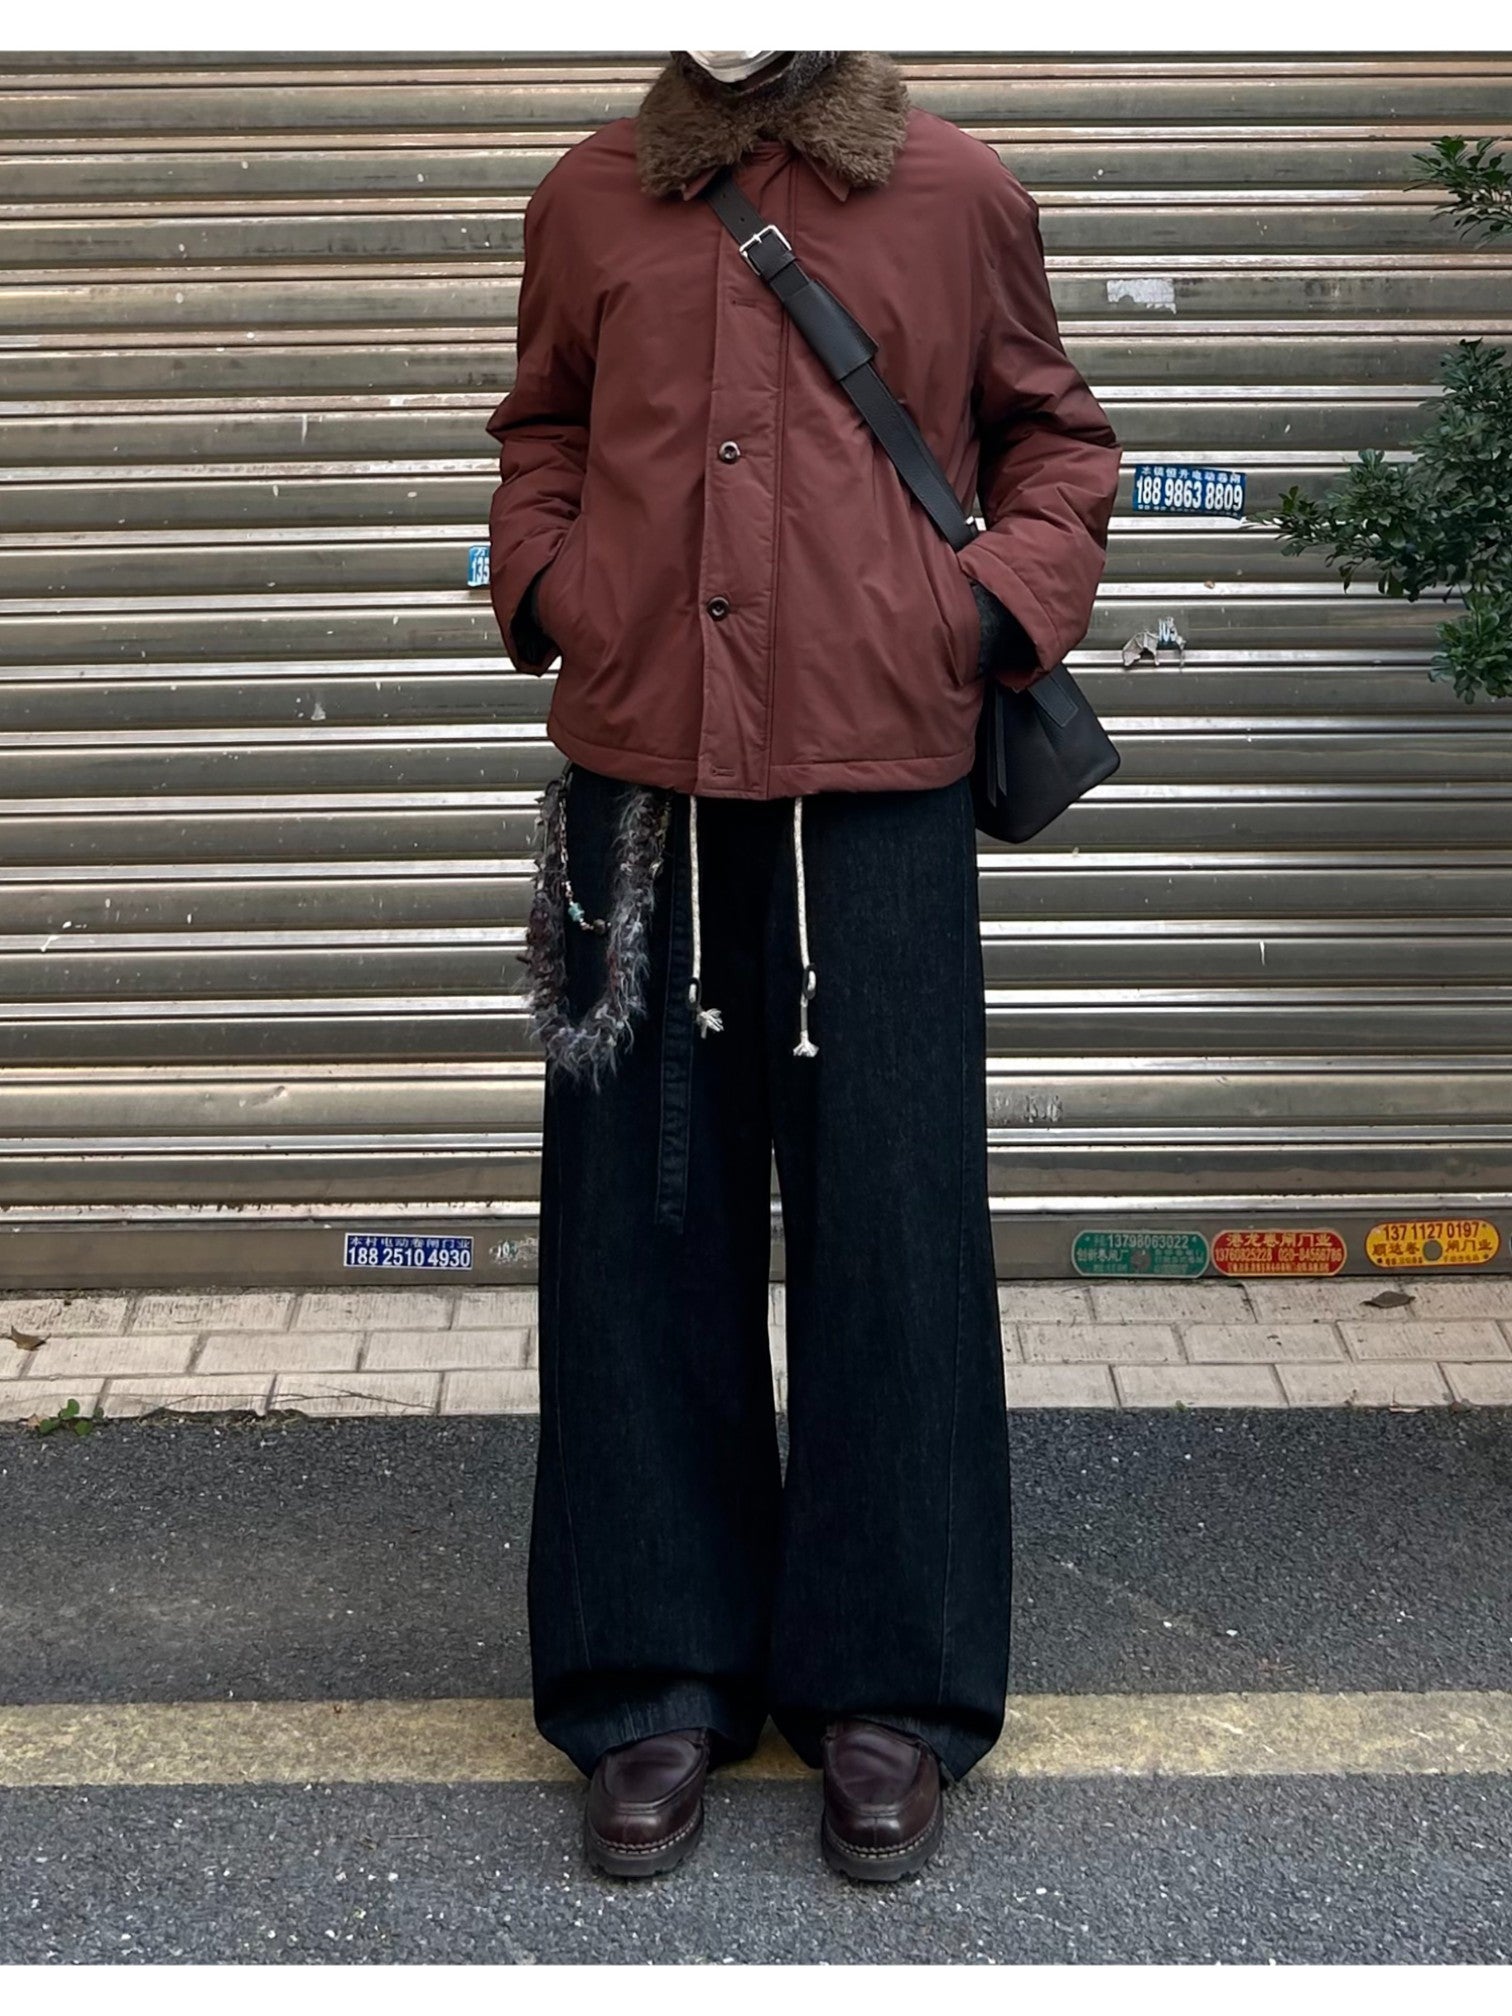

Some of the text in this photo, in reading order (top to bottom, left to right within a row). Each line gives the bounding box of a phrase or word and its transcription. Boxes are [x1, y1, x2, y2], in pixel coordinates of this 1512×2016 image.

[1137, 475, 1162, 505] 188
[1165, 478, 1202, 508] 9863
[1205, 482, 1243, 511] 8809
[1383, 1222, 1479, 1241] 137 1127 0197
[350, 1237, 470, 1249] 本村电动卷闸门业
[1108, 1235, 1189, 1249] 13798063022
[348, 1247, 470, 1267] 188 2510 4930
